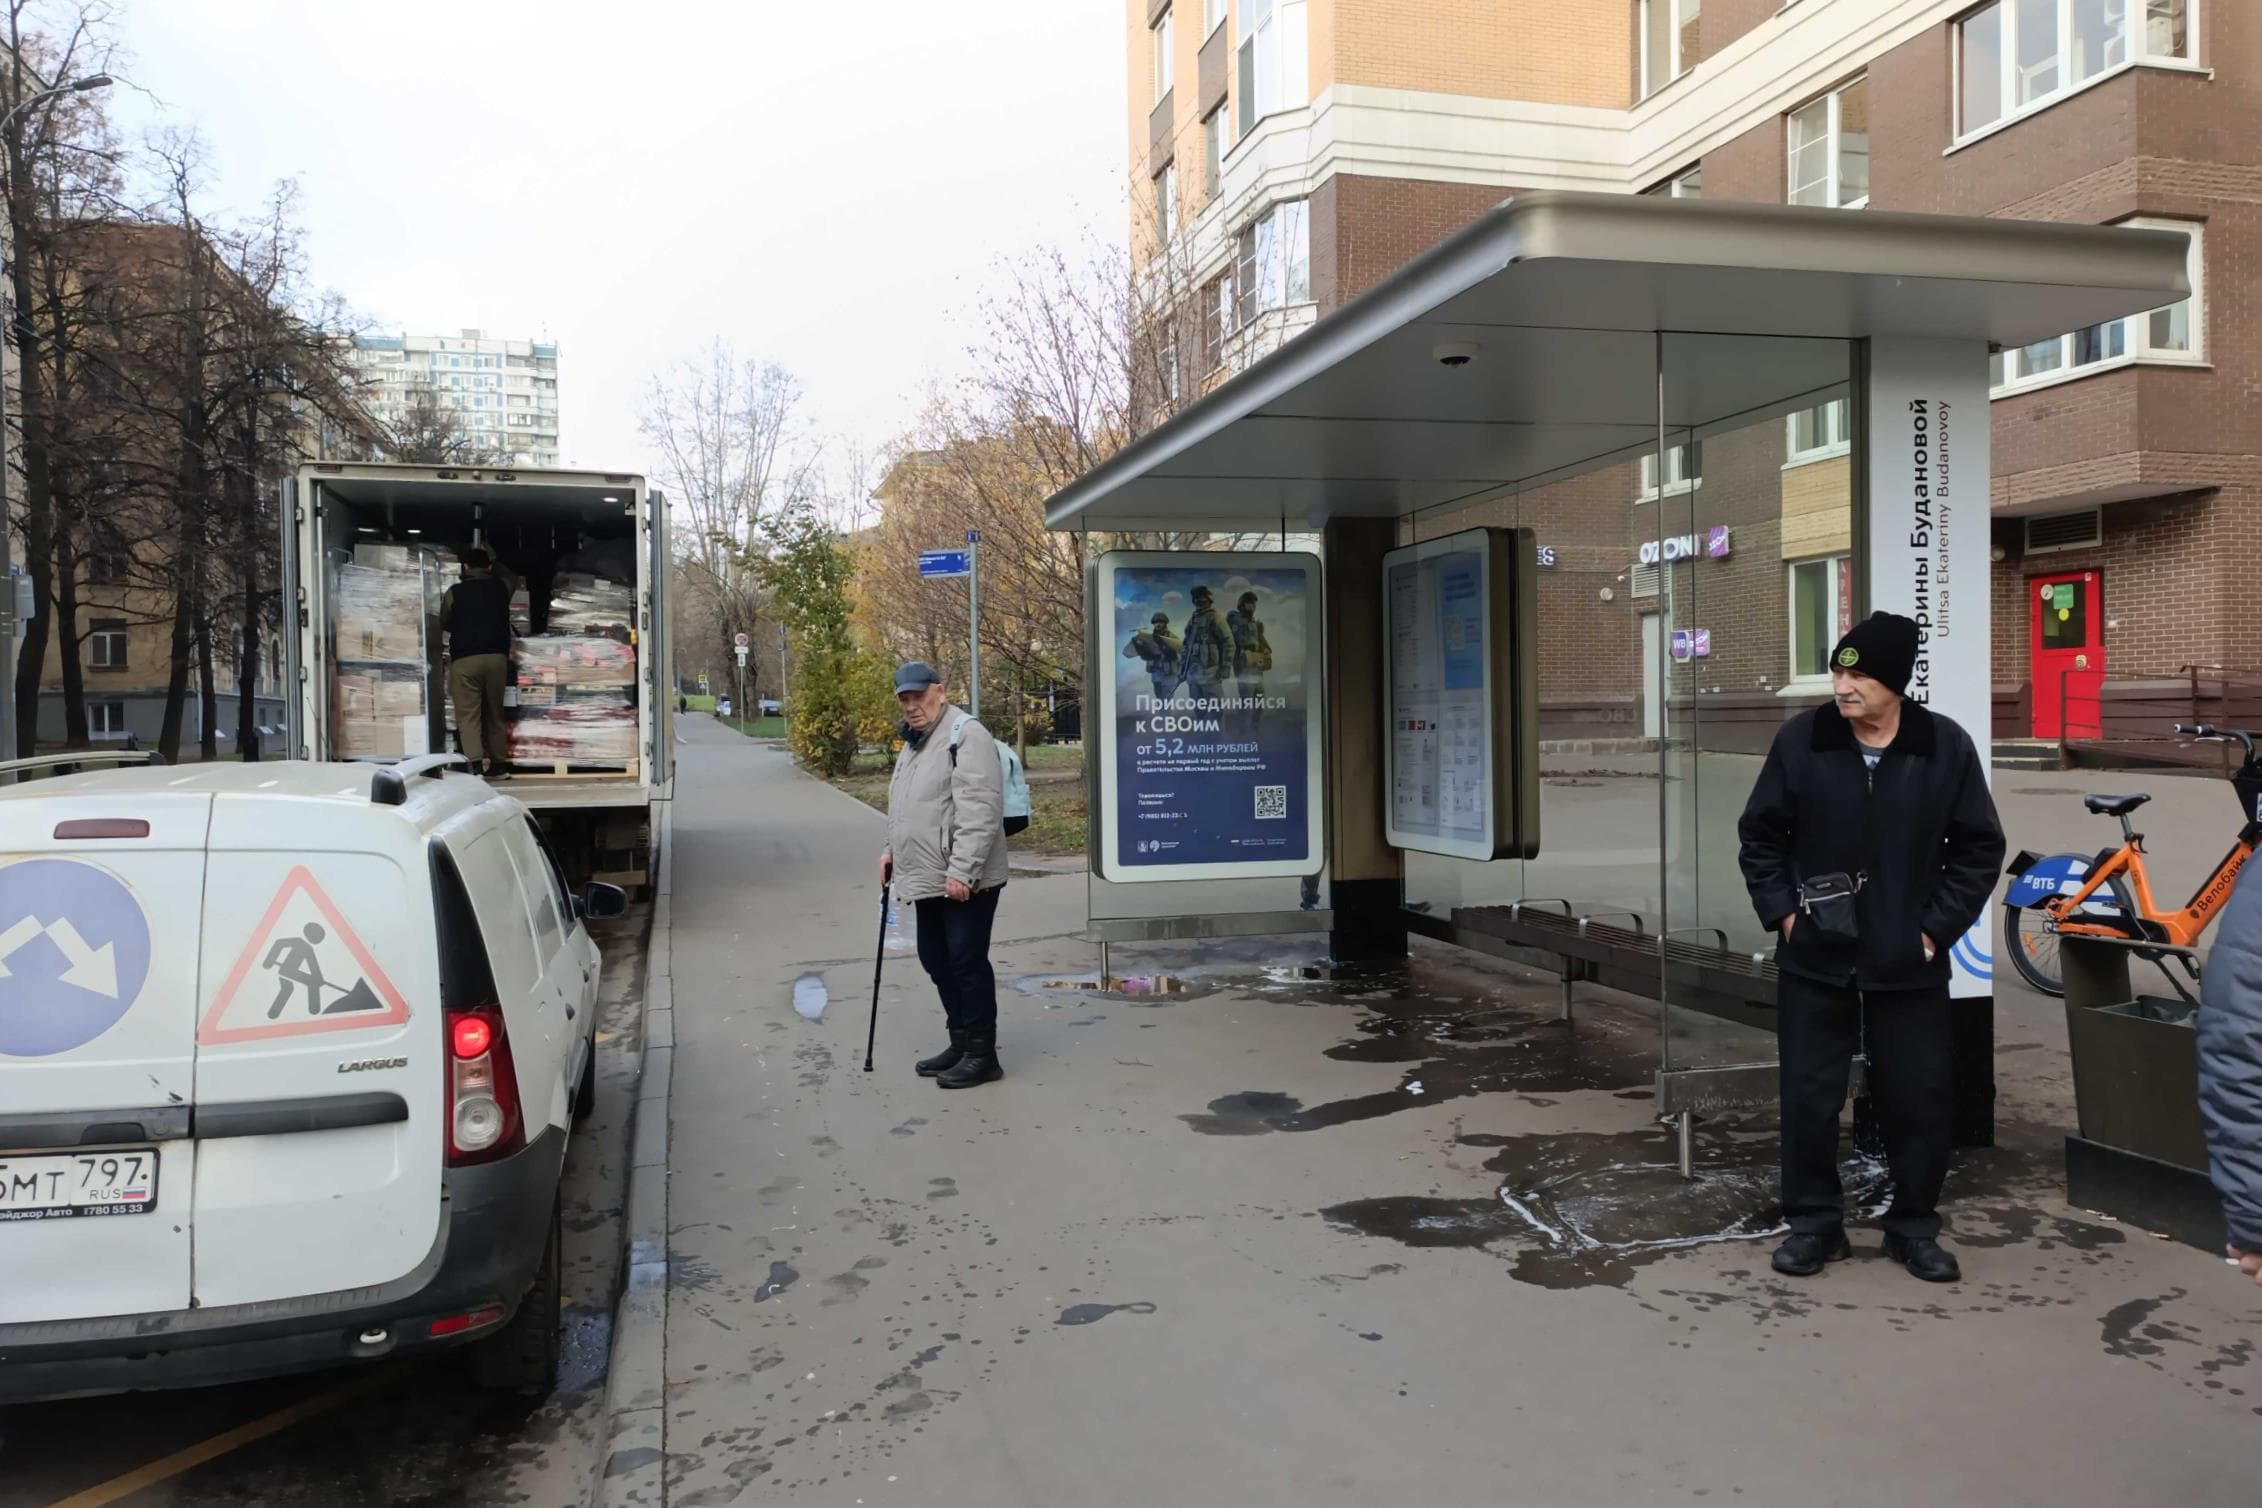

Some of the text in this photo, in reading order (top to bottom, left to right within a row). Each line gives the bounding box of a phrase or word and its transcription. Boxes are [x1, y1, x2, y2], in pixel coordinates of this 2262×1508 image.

[1936, 401, 1951, 637] Ulitsa Ekateriny Budanovoy
[1909, 400, 1933, 704] Екатерины Будановой
[1135, 693, 1286, 714] Присоединяйся
[1136, 716, 1220, 733] к СВОим
[1136, 745, 1152, 755] от
[1155, 738, 1184, 757] 5,2
[1216, 742, 1258, 754] РУБЛЕЙ
[2032, 877, 2056, 890] ВТБ
[337, 1056, 409, 1073] LARGUS
[79, 1156, 143, 1188] 797
[89, 1188, 121, 1200] RUS
[45, 1207, 73, 1217] Авто
[113, 1204, 128, 1214] 55
[128, 1203, 143, 1213] 33
